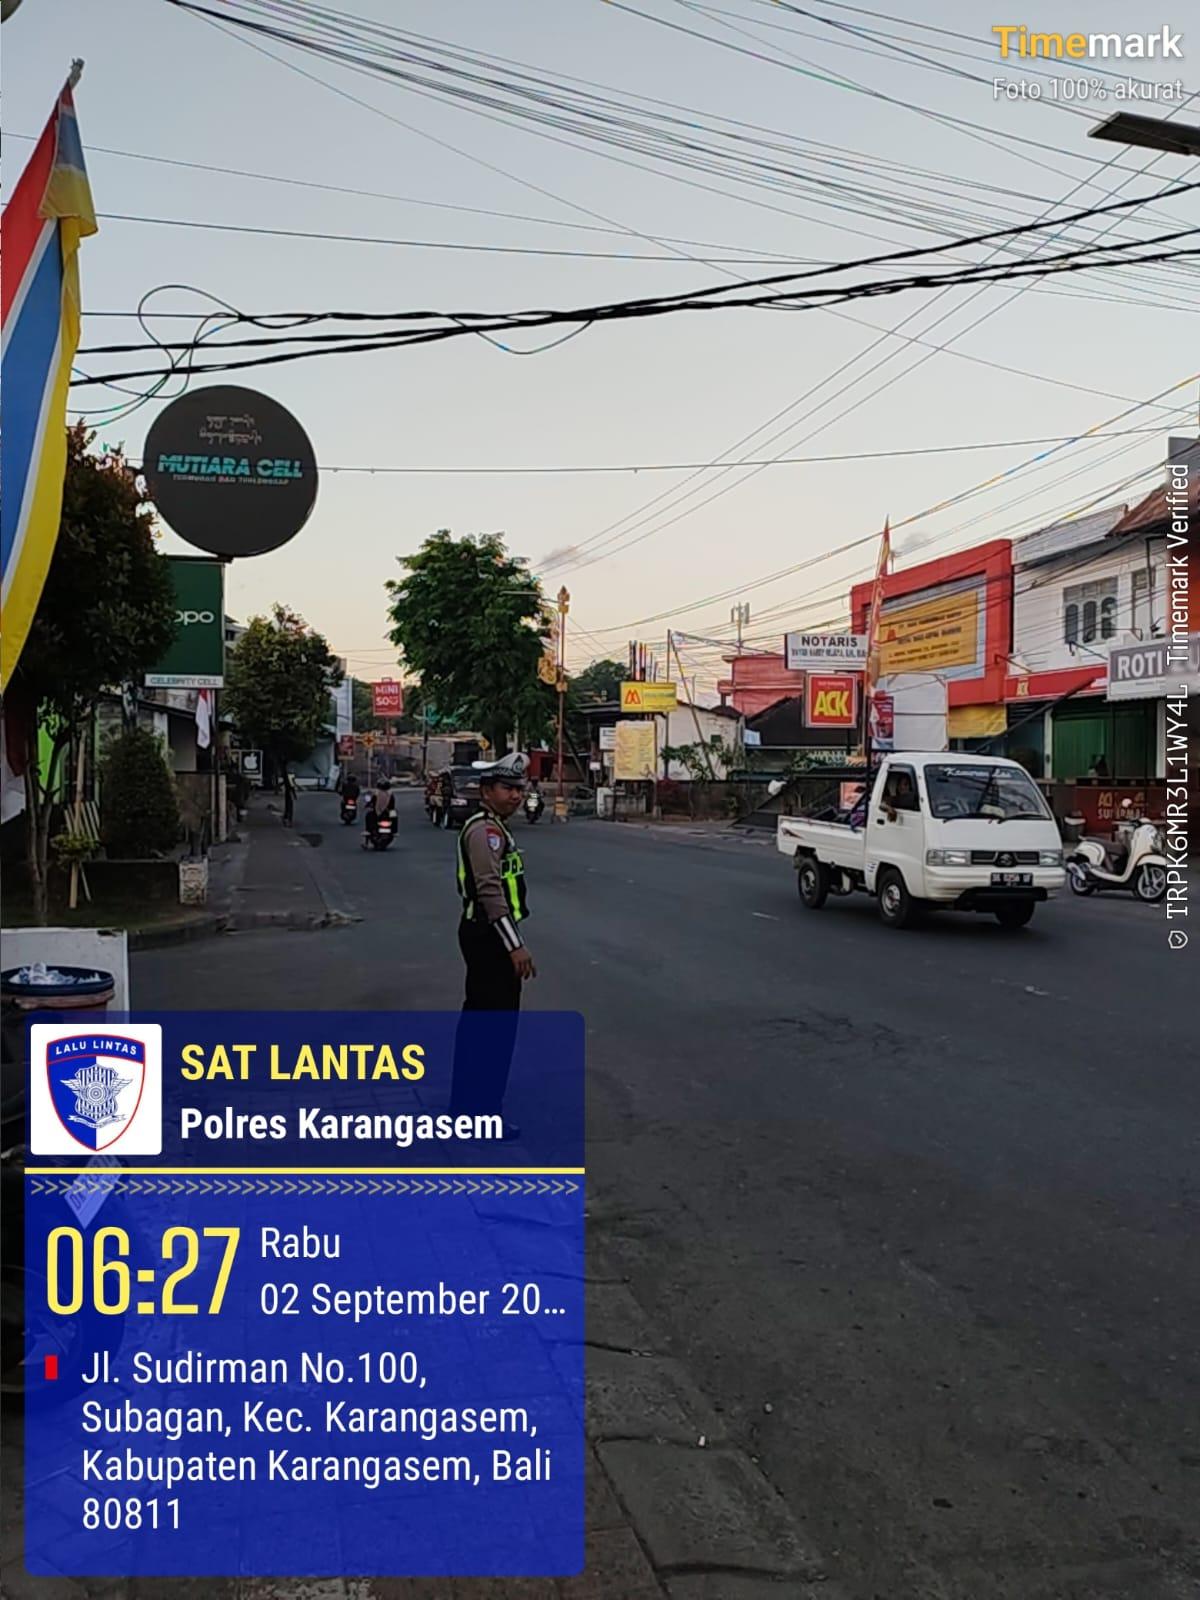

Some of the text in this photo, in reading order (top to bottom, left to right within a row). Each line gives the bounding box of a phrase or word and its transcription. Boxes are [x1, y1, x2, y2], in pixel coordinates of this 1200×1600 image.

[157, 454, 303, 478] MUTIARA CELL
[802, 636, 858, 647] NOTARIS
[1117, 650, 1163, 680] ROTI
[375, 685, 398, 695] MINI
[813, 690, 849, 717] ACK
